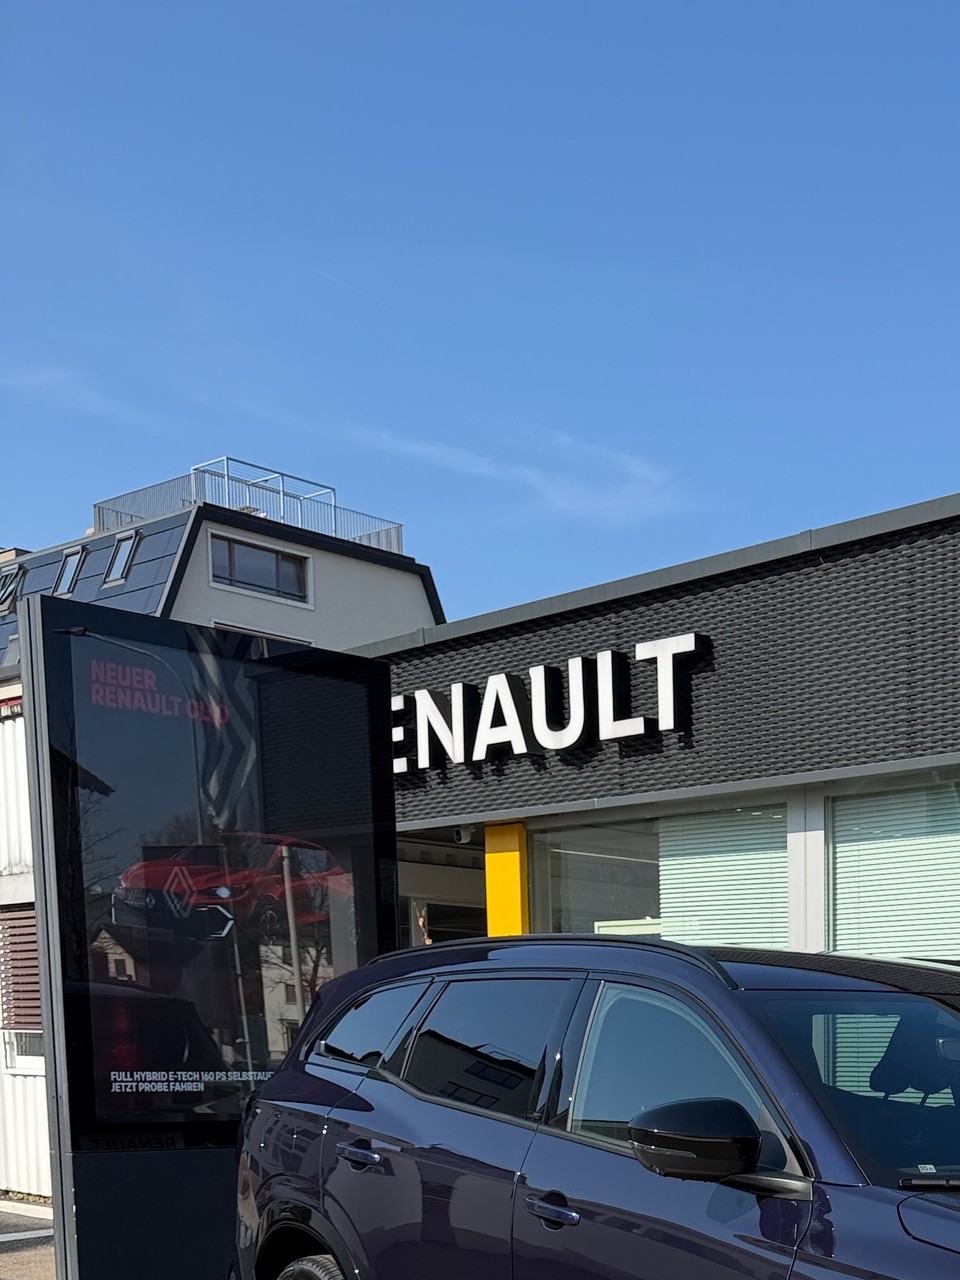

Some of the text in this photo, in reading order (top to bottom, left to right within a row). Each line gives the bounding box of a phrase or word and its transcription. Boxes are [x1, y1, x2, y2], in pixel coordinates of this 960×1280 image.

[91, 659, 158, 692] NEUER
[91, 683, 182, 717] RENAULT
[110, 1071, 132, 1082] FULL
[134, 1071, 168, 1082] HYBRID
[169, 1071, 200, 1082] E-TECH
[201, 1071, 215, 1082] 160
[216, 1071, 227, 1082] PS
[110, 1082, 205, 1093] JETZT PROBE FAHREN
